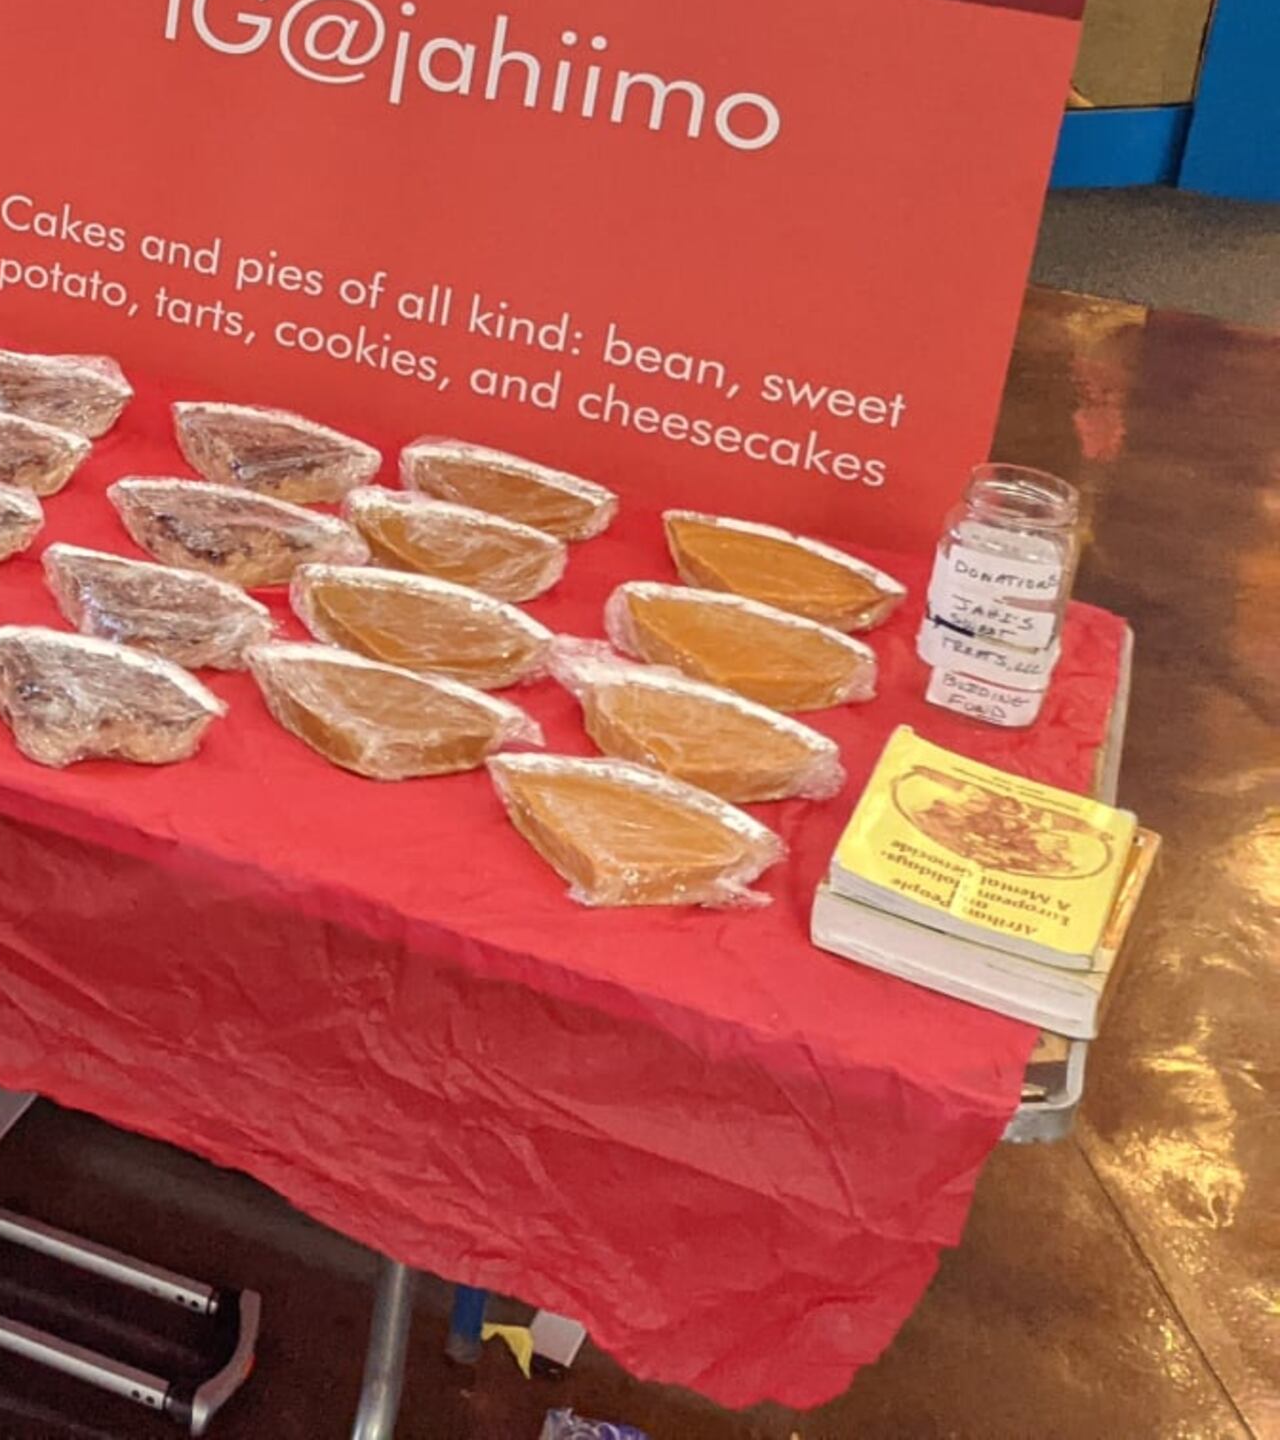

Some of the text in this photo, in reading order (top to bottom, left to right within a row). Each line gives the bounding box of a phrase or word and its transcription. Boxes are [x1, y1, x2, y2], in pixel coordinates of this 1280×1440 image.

[0, 193, 907, 431] Cakes and pies of all kind: bean, sweet
[155, 288, 256, 345] tarts,
[274, 320, 451, 391] cookies,
[469, 366, 560, 411] and
[577, 385, 887, 489] cheesecakes
